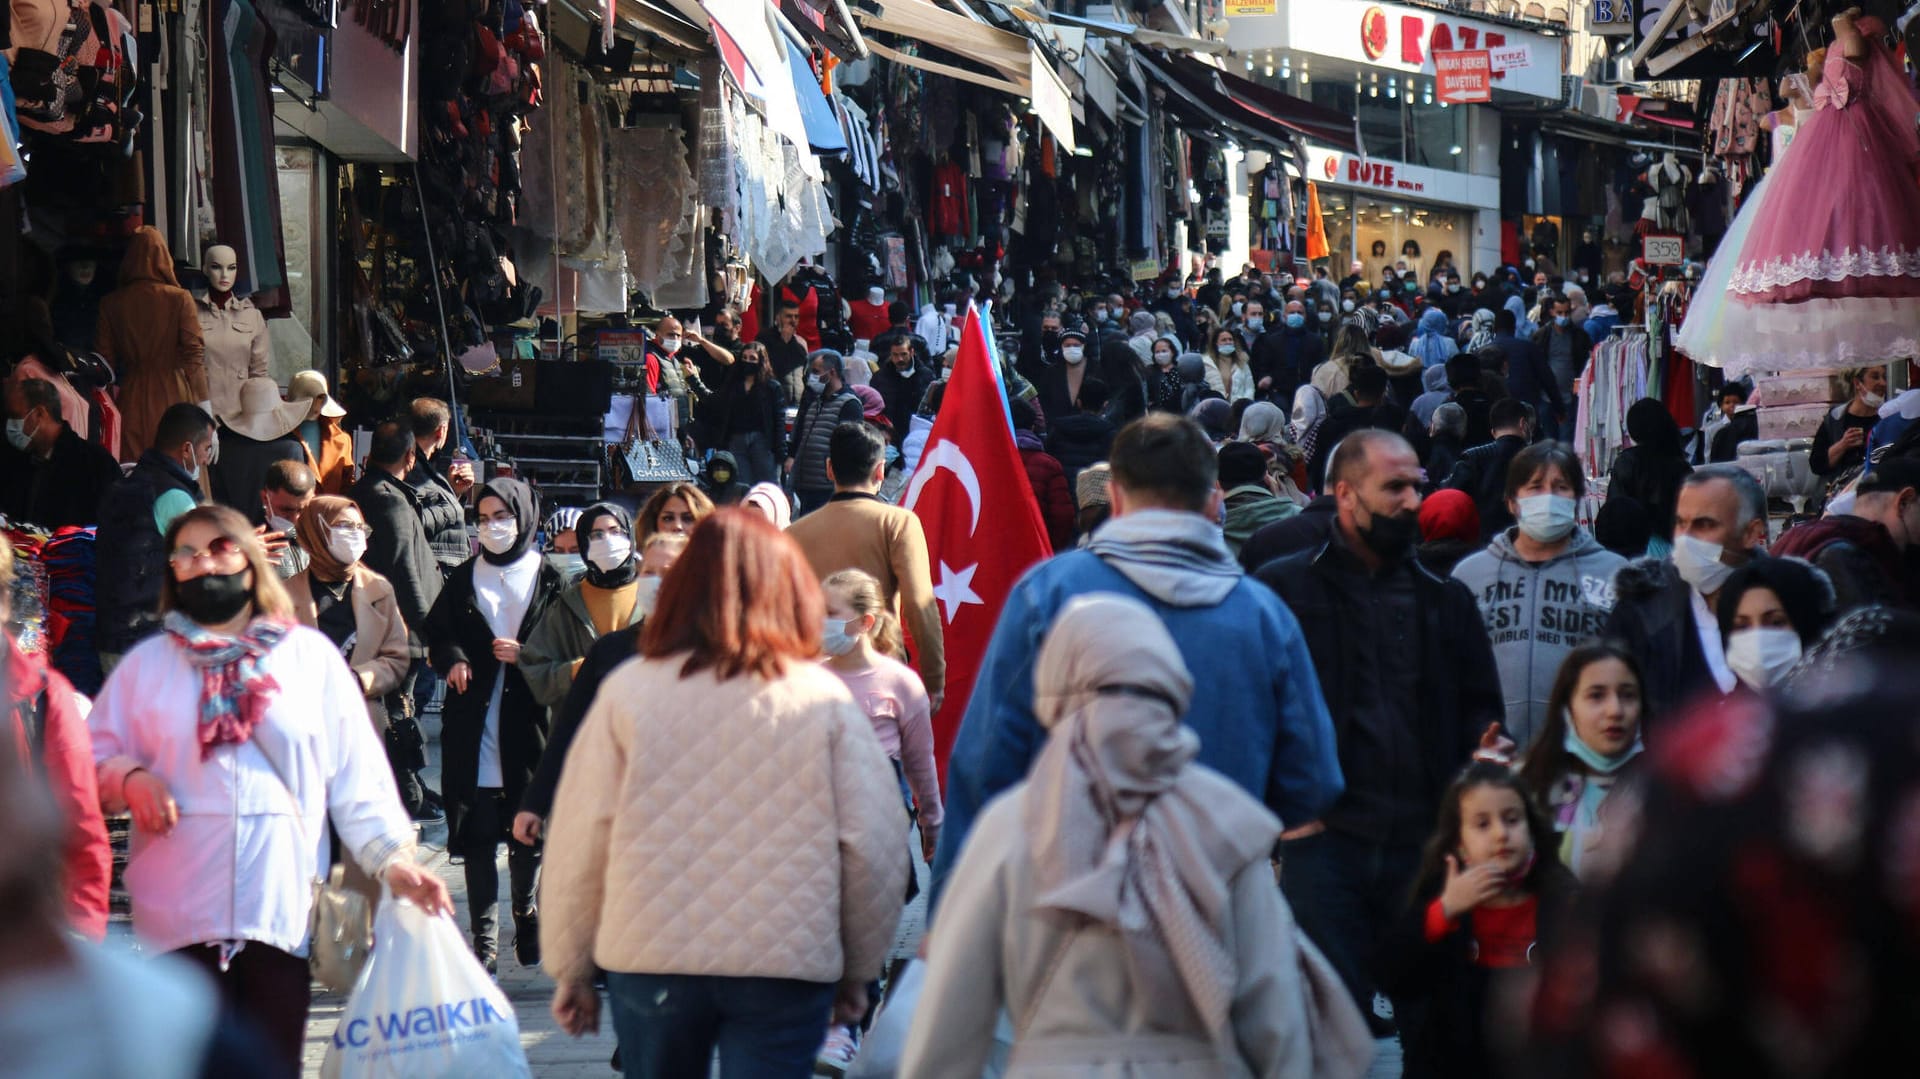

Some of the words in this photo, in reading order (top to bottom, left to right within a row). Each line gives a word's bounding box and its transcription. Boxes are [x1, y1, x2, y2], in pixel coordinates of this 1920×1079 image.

[621, 346, 641, 361] 50
[637, 469, 687, 478] CHANEL
[1488, 605, 1522, 631] EST
